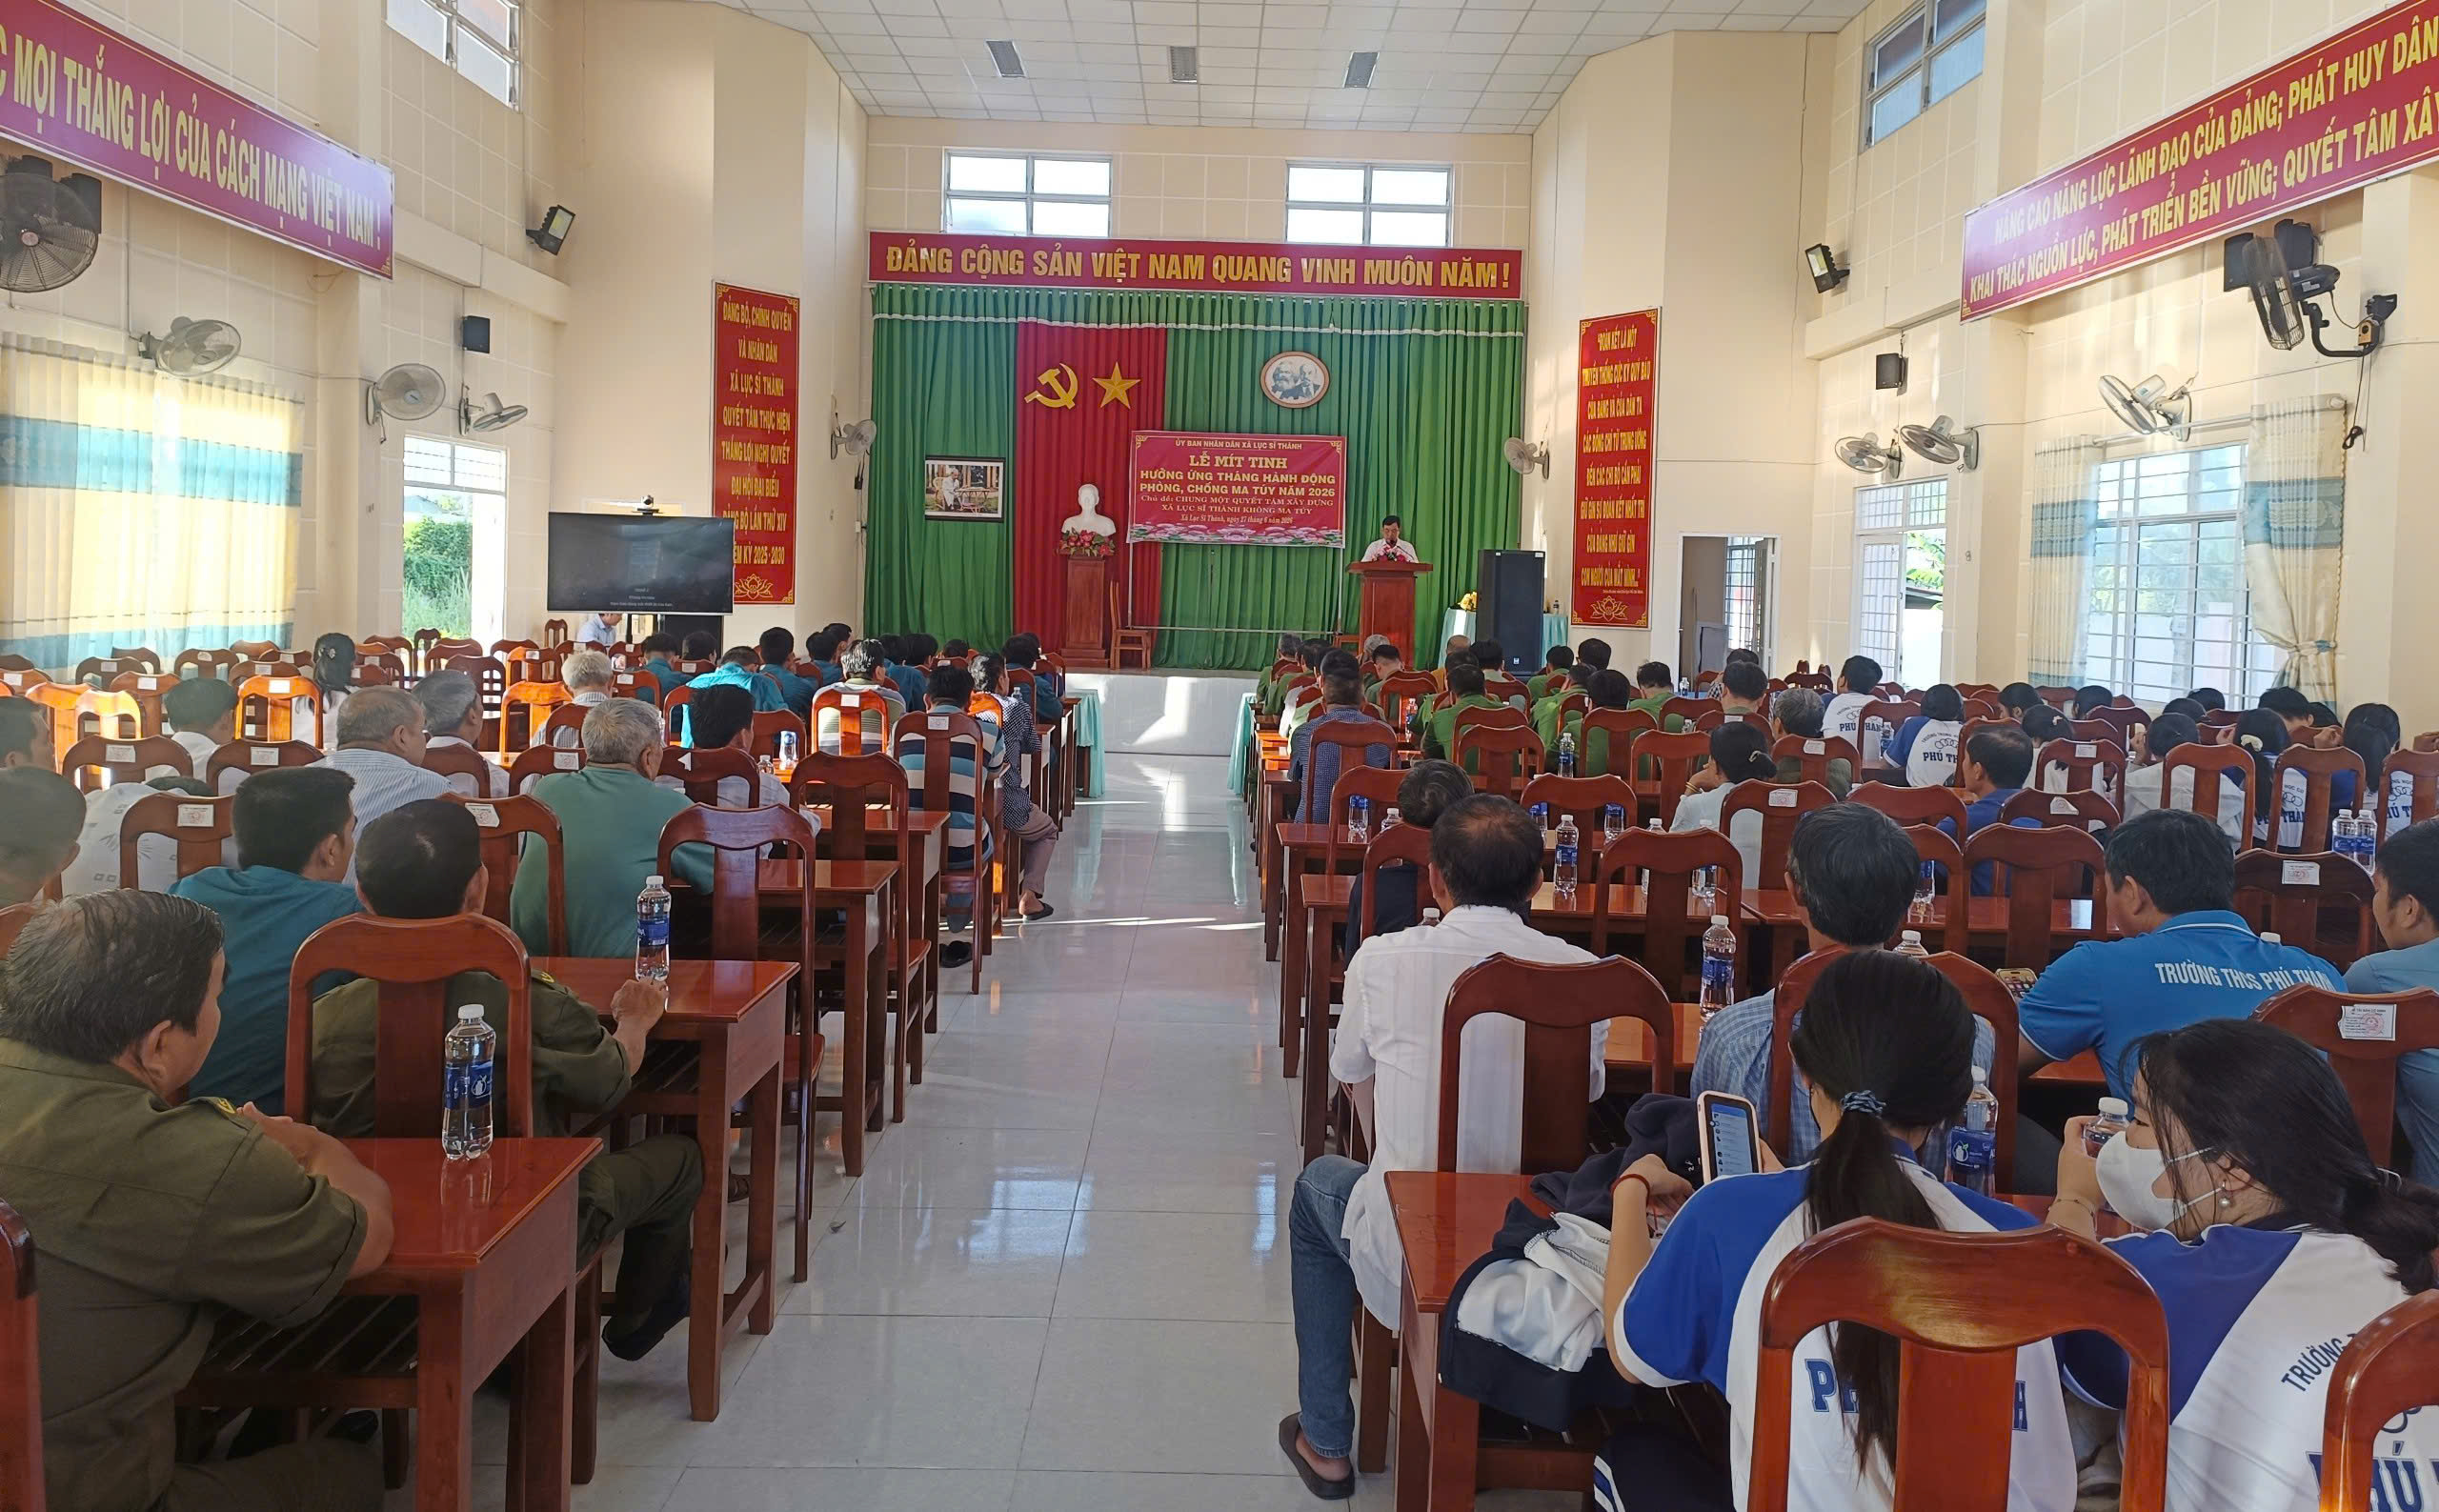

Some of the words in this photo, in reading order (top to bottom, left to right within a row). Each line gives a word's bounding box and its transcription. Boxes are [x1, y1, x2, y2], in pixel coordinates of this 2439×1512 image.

[2027, 195, 2050, 231] CAO
[2053, 181, 2086, 222] NĂNG
[2090, 162, 2115, 211] LỰC
[2119, 148, 2155, 192] LÃNH
[2160, 131, 2189, 178] ĐẠO
[2193, 107, 2226, 160] CỦA
[2229, 89, 2284, 145] ĐẢNG;
[2288, 58, 2339, 119] PHÁT
[2344, 39, 2388, 95] HUY
[2392, 15, 2439, 74] DÂN
[14, 33, 56, 134] MỌI
[64, 44, 134, 151] THẮNG
[141, 91, 170, 180] LỢI
[175, 93, 211, 183] CỦA
[216, 118, 259, 202] CÁCH
[265, 151, 308, 229] MẠNG
[312, 168, 342, 247] VIỆT
[346, 189, 374, 248] NAM
[1970, 269, 1994, 303] KHAI
[1997, 252, 2025, 293] THÁC
[2027, 232, 2067, 282] NGUỒN
[2070, 226, 2098, 272] LỰC,
[2101, 208, 2138, 255] PHÁT
[2142, 179, 2185, 240] TRIỂN
[2188, 170, 2221, 223] BỀN
[2226, 158, 2278, 209] VỮNG;
[2283, 116, 2348, 189] QUYẾT
[2353, 108, 2397, 162] TÂM
[887, 238, 953, 273] ĐẢNG
[960, 243, 1024, 279] CỘNG
[1033, 242, 1082, 277] SẢN
[1091, 247, 1140, 283] VIỆT
[1148, 253, 1204, 280] NAM
[1212, 254, 1292, 283] QUANG
[1300, 257, 1356, 284] VINH
[1363, 254, 1433, 287] MUÔN
[1189, 451, 1210, 466] LỄ
[1214, 454, 1244, 467] MÍT
[1248, 456, 1288, 469] TINH
[1140, 468, 1183, 480] HƯỞNG
[1187, 469, 1213, 480] ỨNG
[1218, 471, 1259, 482] THÁNG
[1262, 472, 1297, 483] HÀNH
[1301, 473, 1336, 486] ĐỘNG
[1140, 481, 1183, 494] PHÒNG,
[1187, 482, 1228, 494] CHỐNG
[1231, 486, 1249, 494] MA
[1253, 484, 1276, 494] TÚY
[1279, 485, 1304, 495] NĂM
[1308, 488, 1335, 496] 2026
[1211, 495, 1229, 504] MỘT
[2155, 959, 2222, 986] TRƯỜNG
[2220, 968, 2263, 991] THCS
[2259, 966, 2295, 991] PHÚ
